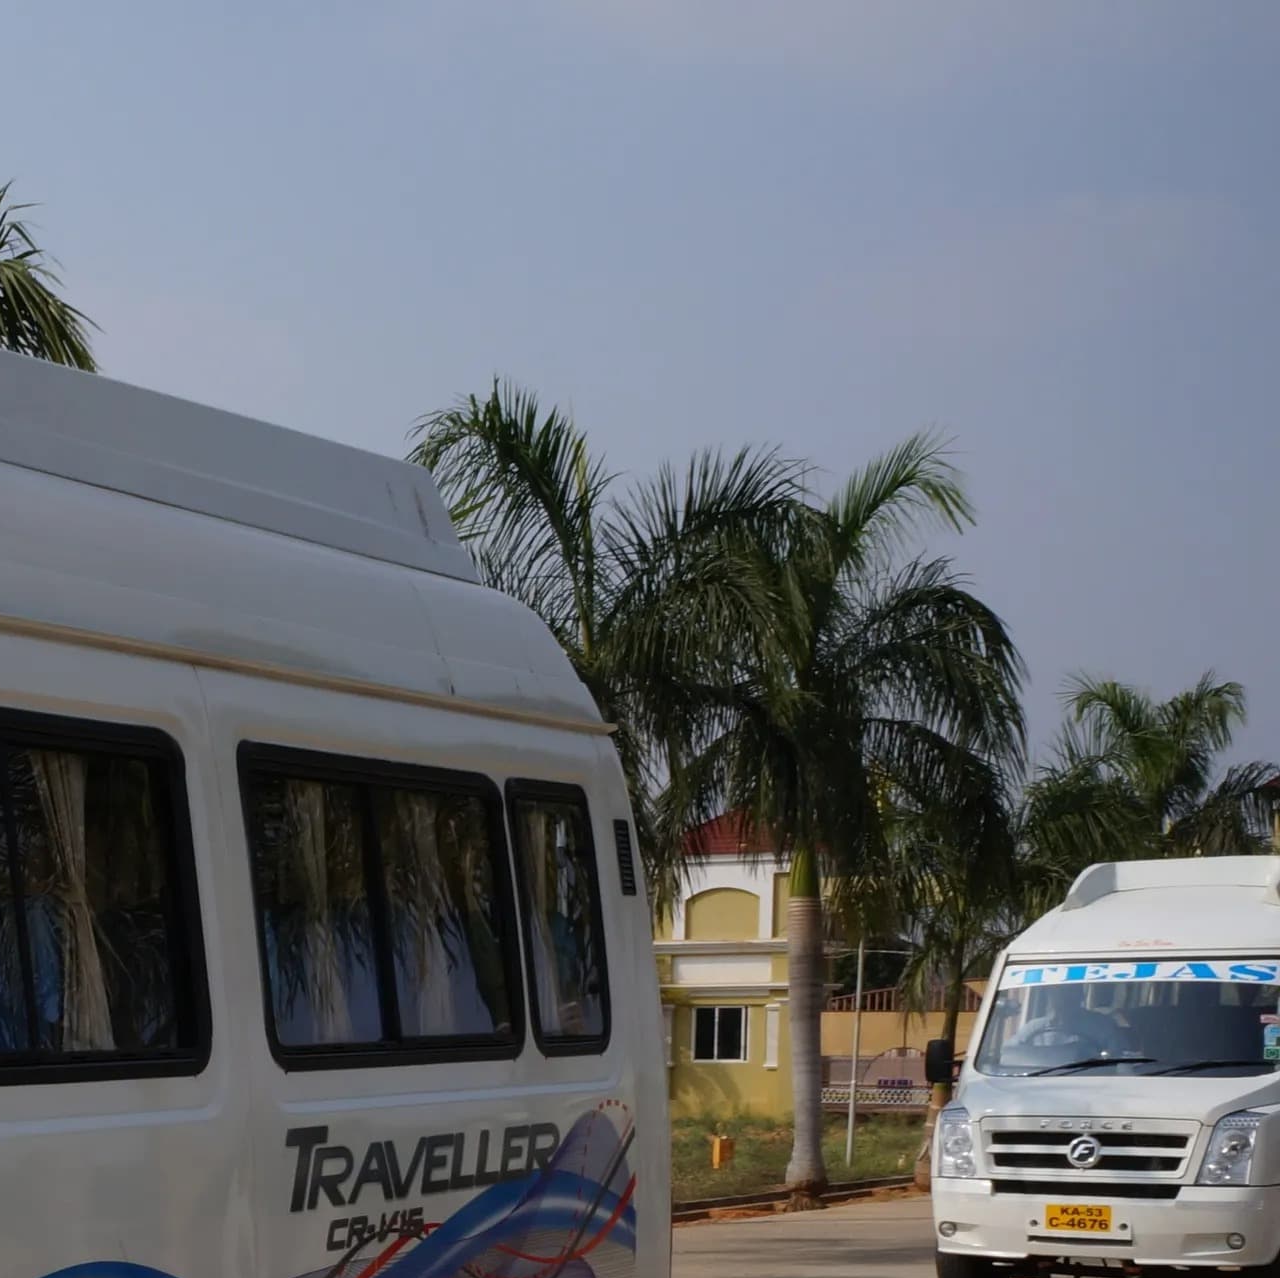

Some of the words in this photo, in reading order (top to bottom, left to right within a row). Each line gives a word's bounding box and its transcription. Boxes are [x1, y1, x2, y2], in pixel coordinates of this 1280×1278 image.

[1011, 963, 1278, 985] TEJAS
[1040, 1120, 1133, 1131] FORCE
[285, 1123, 560, 1213] TRAVELLER
[1060, 1207, 1103, 1217] KA-53
[1049, 1217, 1109, 1230] C-4676
